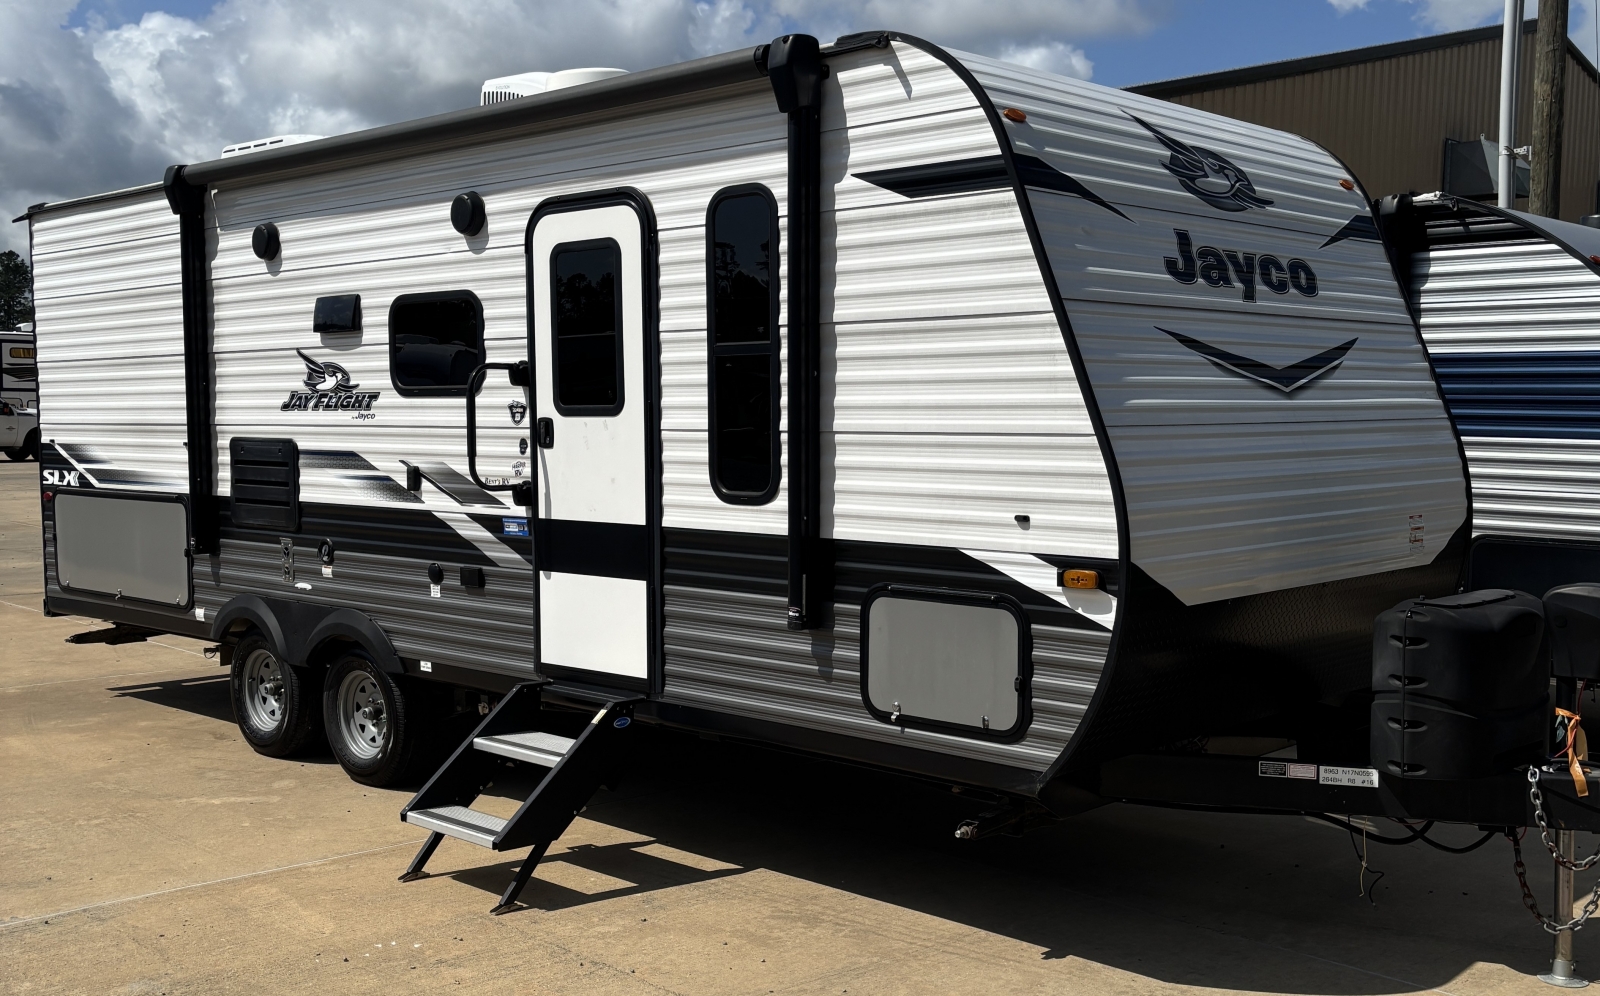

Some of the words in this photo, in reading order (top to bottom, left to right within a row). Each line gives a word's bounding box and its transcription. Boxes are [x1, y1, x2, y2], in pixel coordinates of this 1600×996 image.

[1163, 228, 1319, 303] Jayco
[281, 391, 318, 411] JAY
[312, 392, 381, 411] FLIGHT
[357, 411, 376, 421] Jayco
[42, 469, 80, 487] SLX
